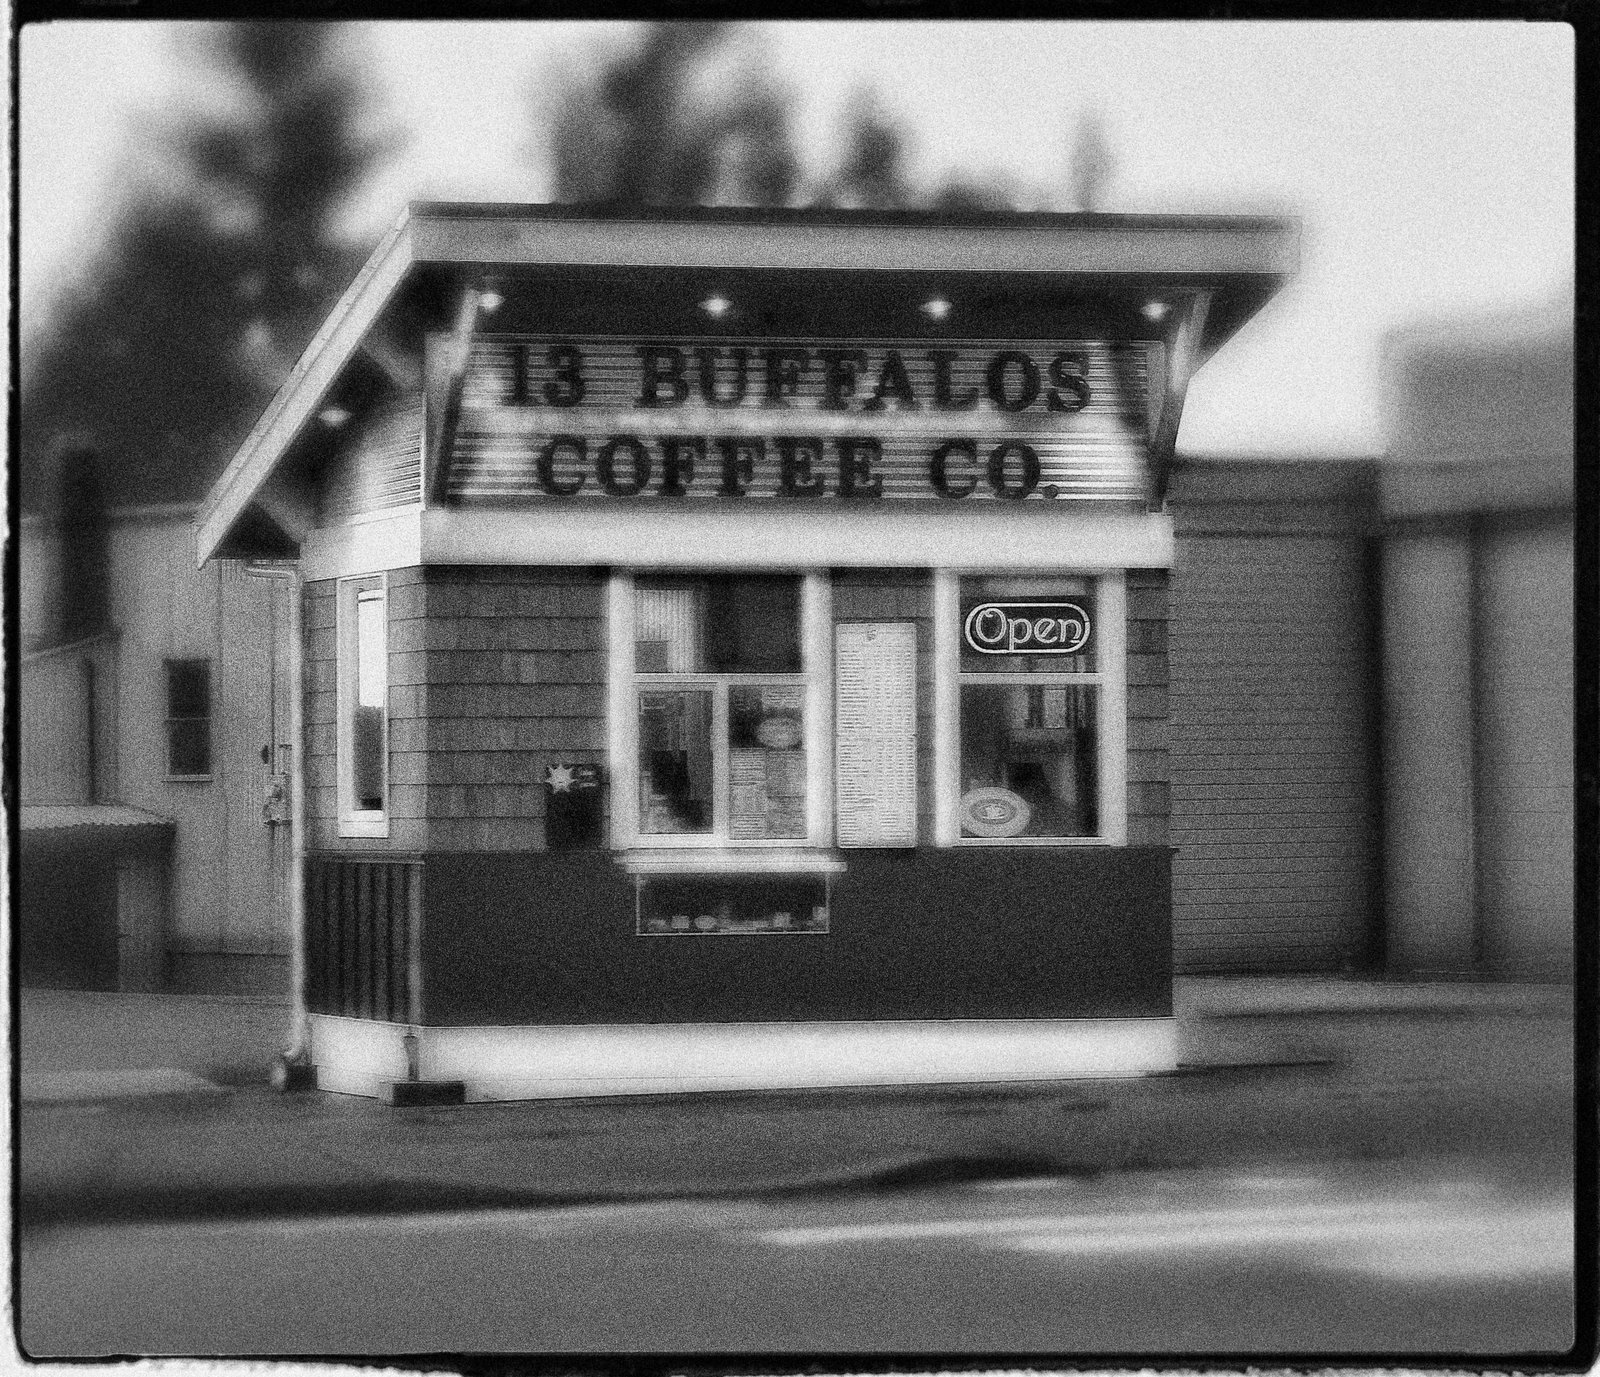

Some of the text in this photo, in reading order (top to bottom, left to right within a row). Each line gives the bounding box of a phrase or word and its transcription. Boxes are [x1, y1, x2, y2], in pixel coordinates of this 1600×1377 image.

[503, 345, 1092, 413] 13 BUFFALOS
[536, 433, 1060, 500] COFFEE CO.
[975, 607, 1082, 651] Open
